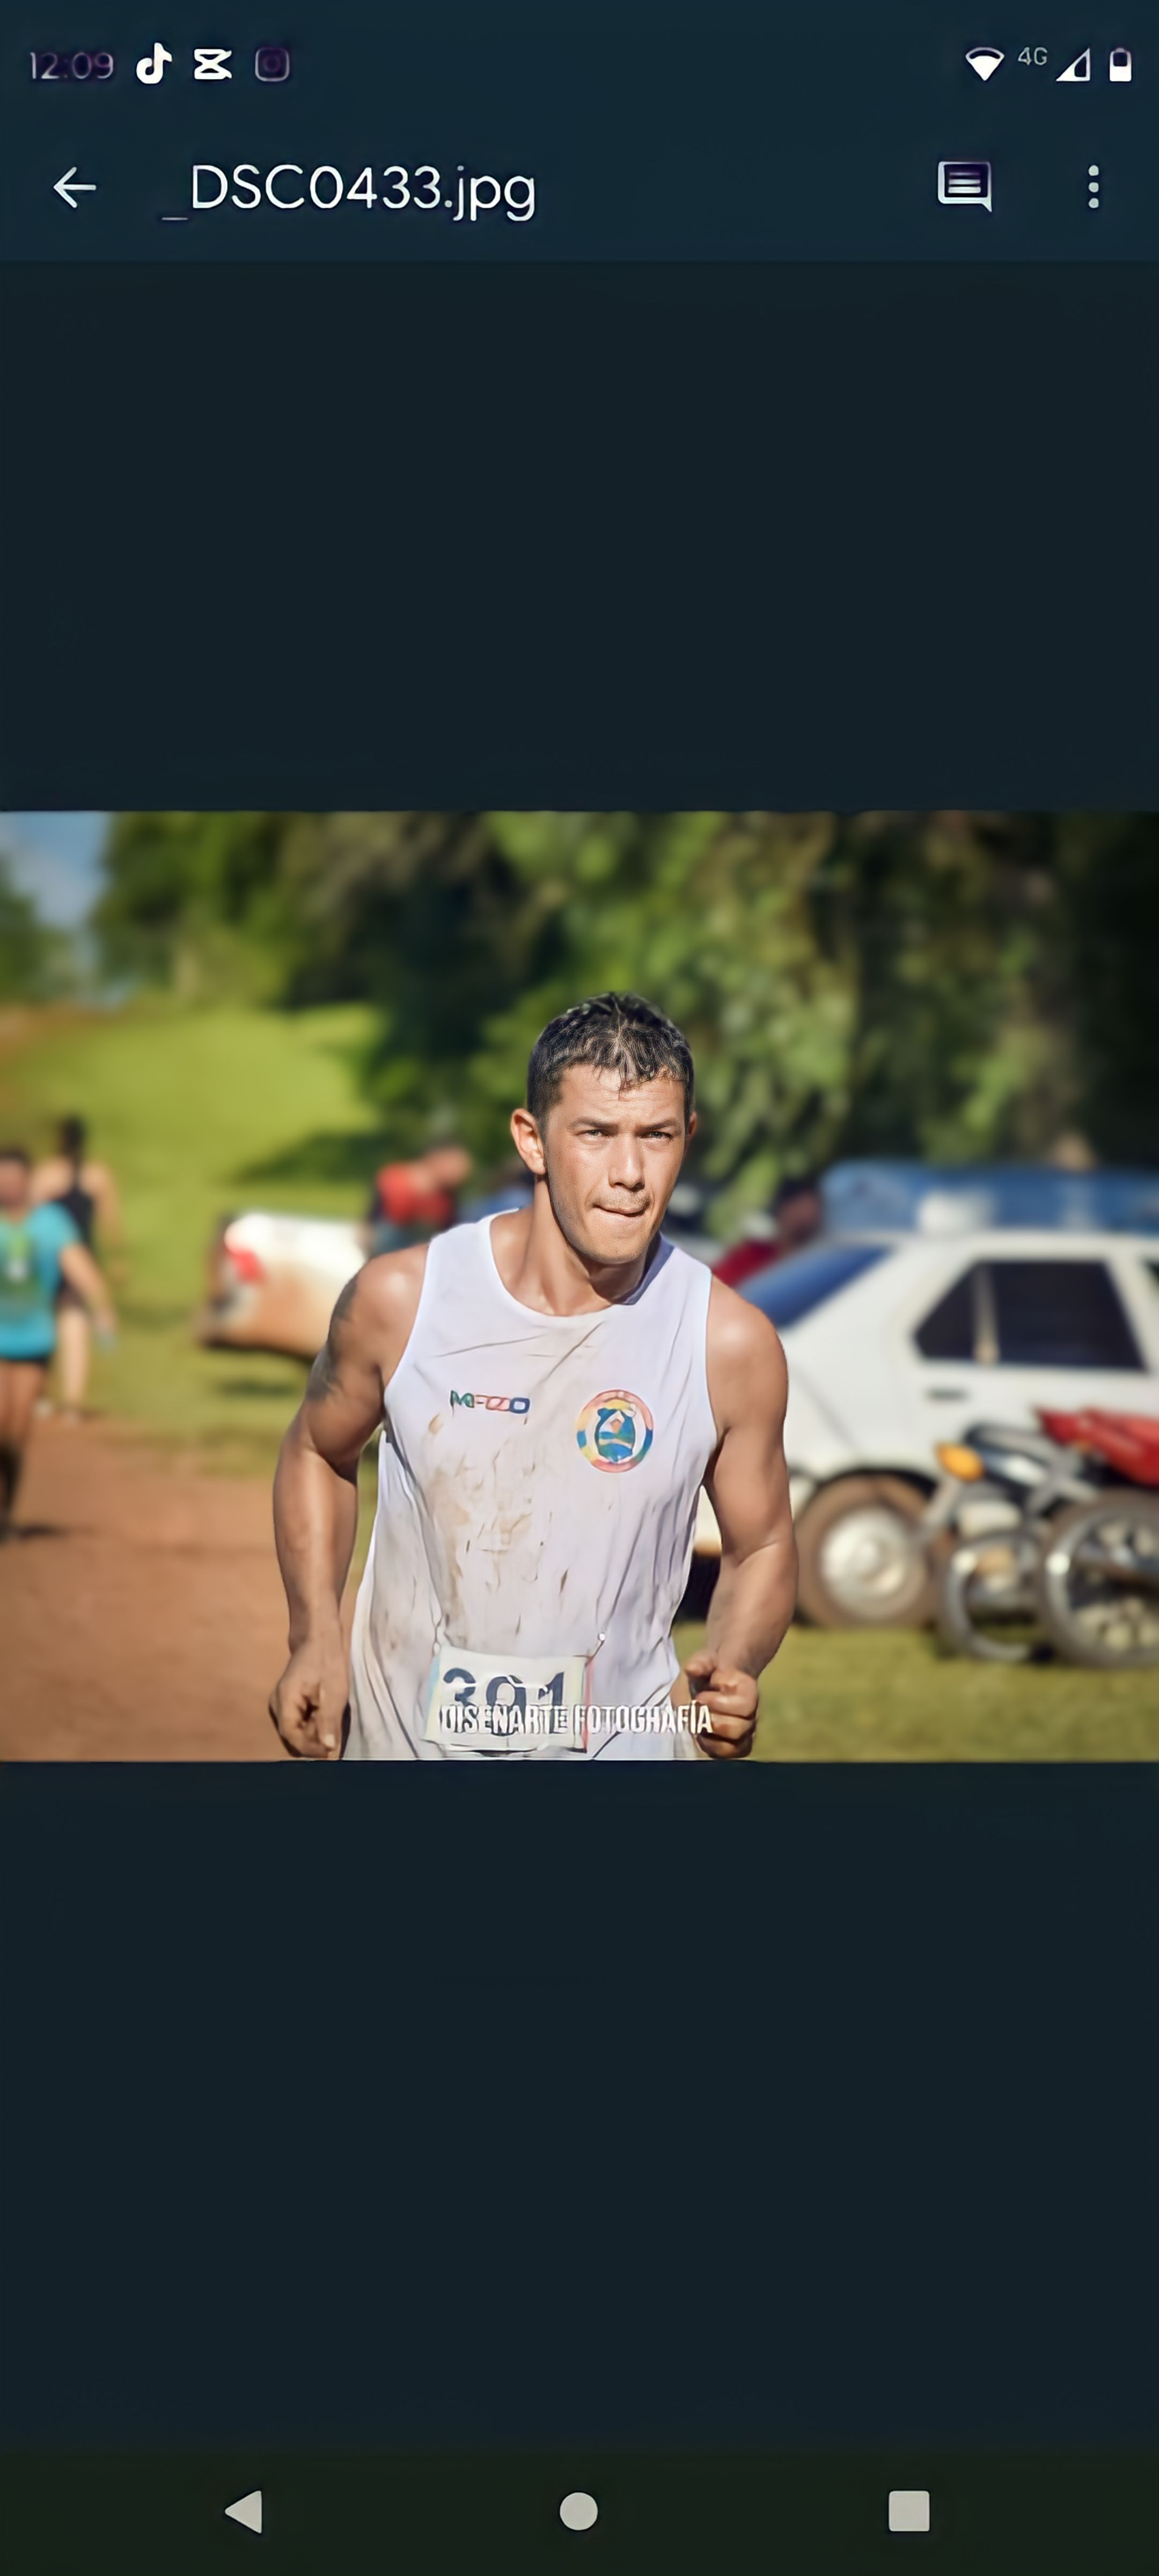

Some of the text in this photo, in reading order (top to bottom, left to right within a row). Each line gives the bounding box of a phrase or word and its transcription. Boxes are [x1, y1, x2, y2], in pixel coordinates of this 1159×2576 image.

[31, 52, 113, 79] 12:09
[1017, 47, 1048, 65] 4G
[162, 164, 535, 222] _DSC0433.jpg
